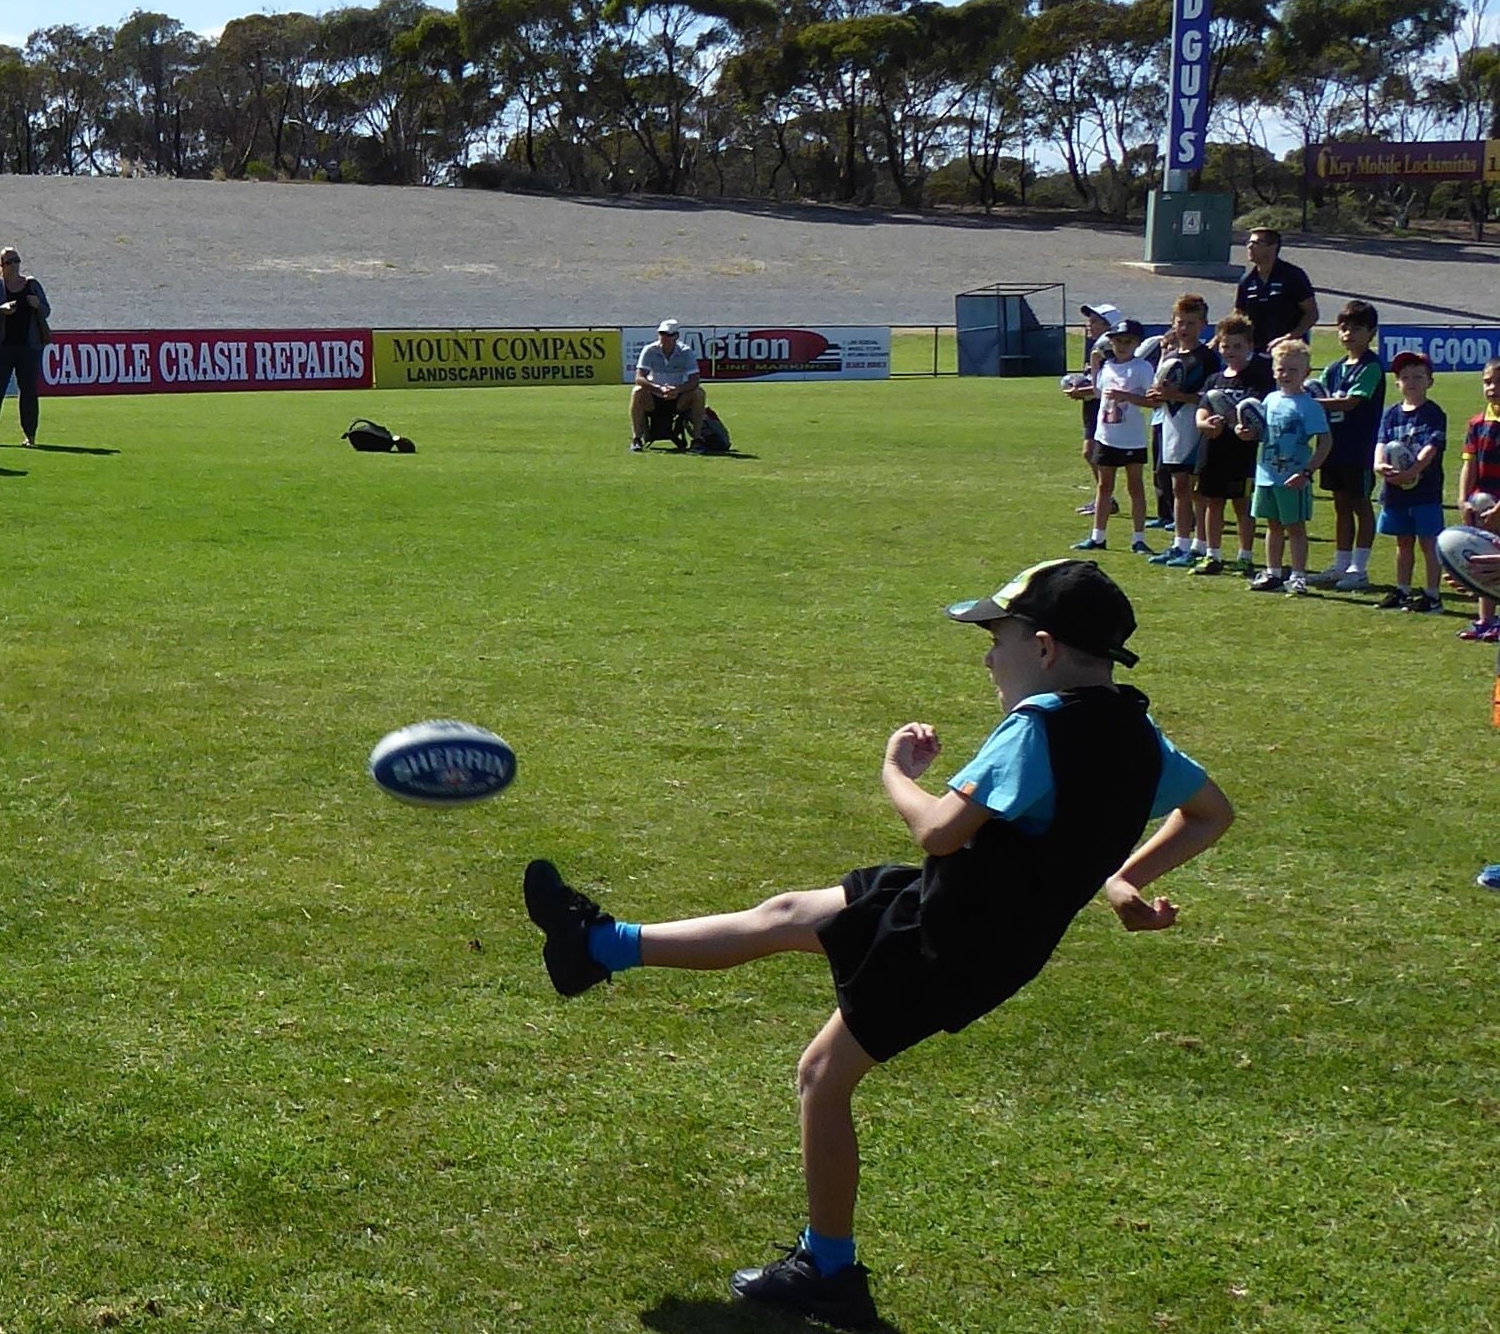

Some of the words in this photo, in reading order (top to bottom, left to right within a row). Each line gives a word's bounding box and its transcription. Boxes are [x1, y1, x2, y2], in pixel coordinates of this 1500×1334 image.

[1178, 30, 1202, 163] GUYS
[392, 336, 481, 363] MOUNT
[492, 336, 606, 361] COMPASS
[684, 331, 790, 361] Action
[1429, 337, 1492, 365] GOOD
[42, 343, 150, 385] CADDLE
[159, 341, 248, 383] CRASH
[254, 340, 364, 380] REPAIRS
[407, 366, 516, 382] LANDSCAPING
[522, 365, 594, 380] SUPPLIES
